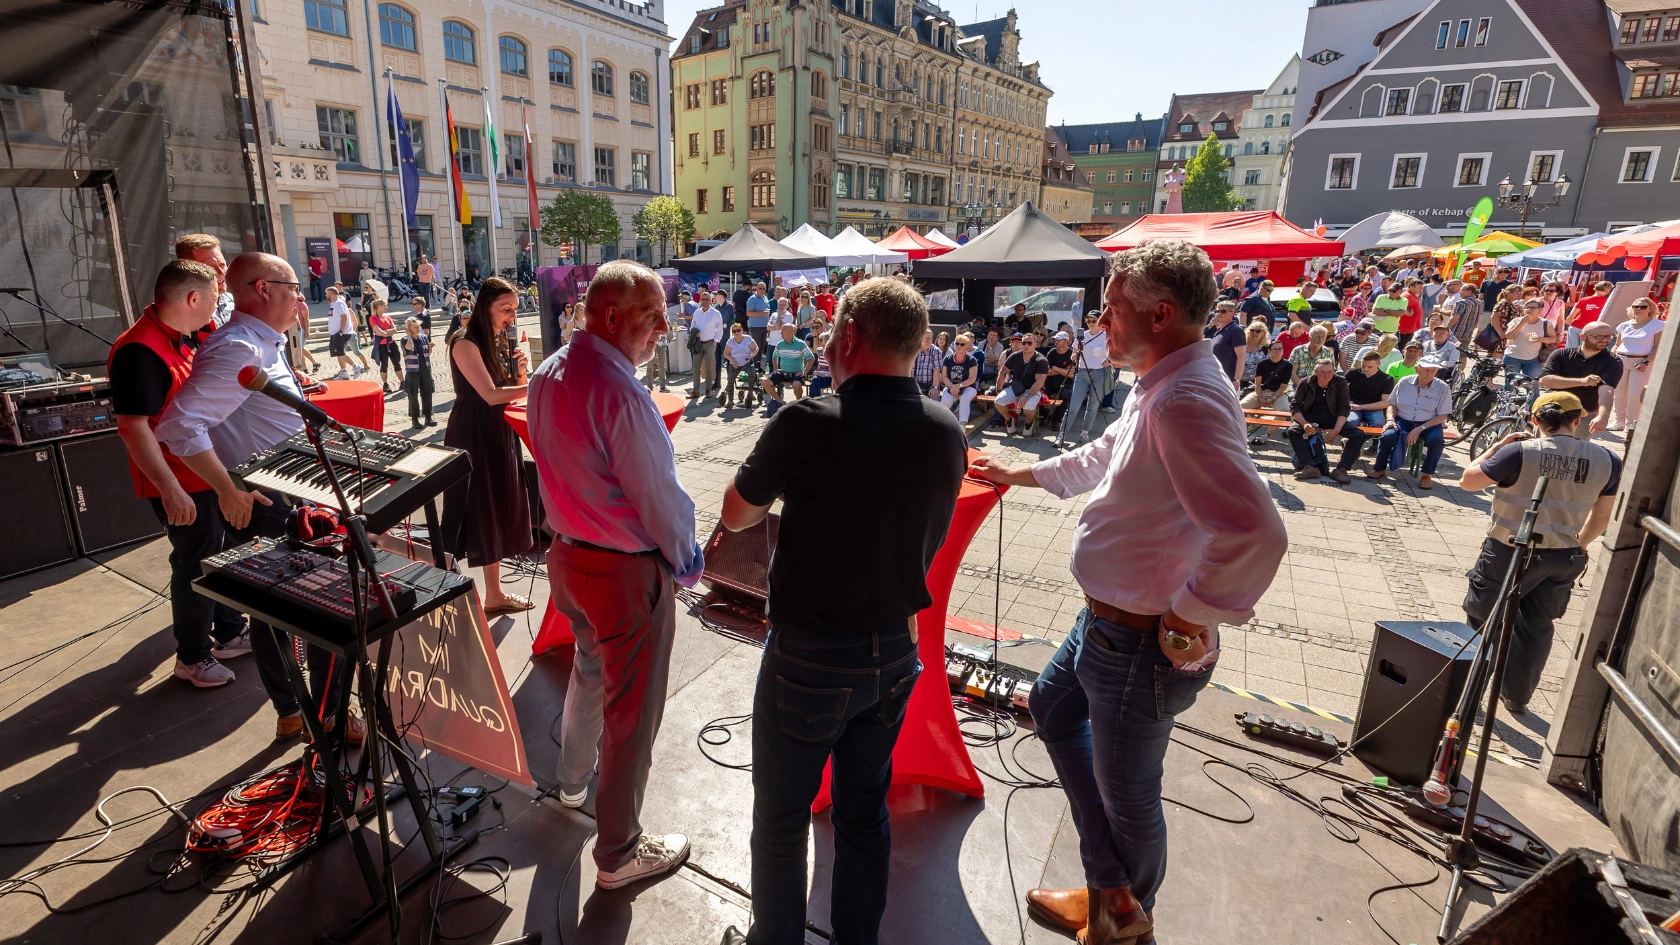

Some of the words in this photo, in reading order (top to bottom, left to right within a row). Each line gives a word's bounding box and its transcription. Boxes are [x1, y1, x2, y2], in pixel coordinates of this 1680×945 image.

[1311, 52, 1339, 63] ALEX
[922, 210, 939, 219] CORNER
[1418, 207, 1430, 216] of
[1431, 207, 1464, 217] Kebap
[76, 485, 87, 513] Palmer
